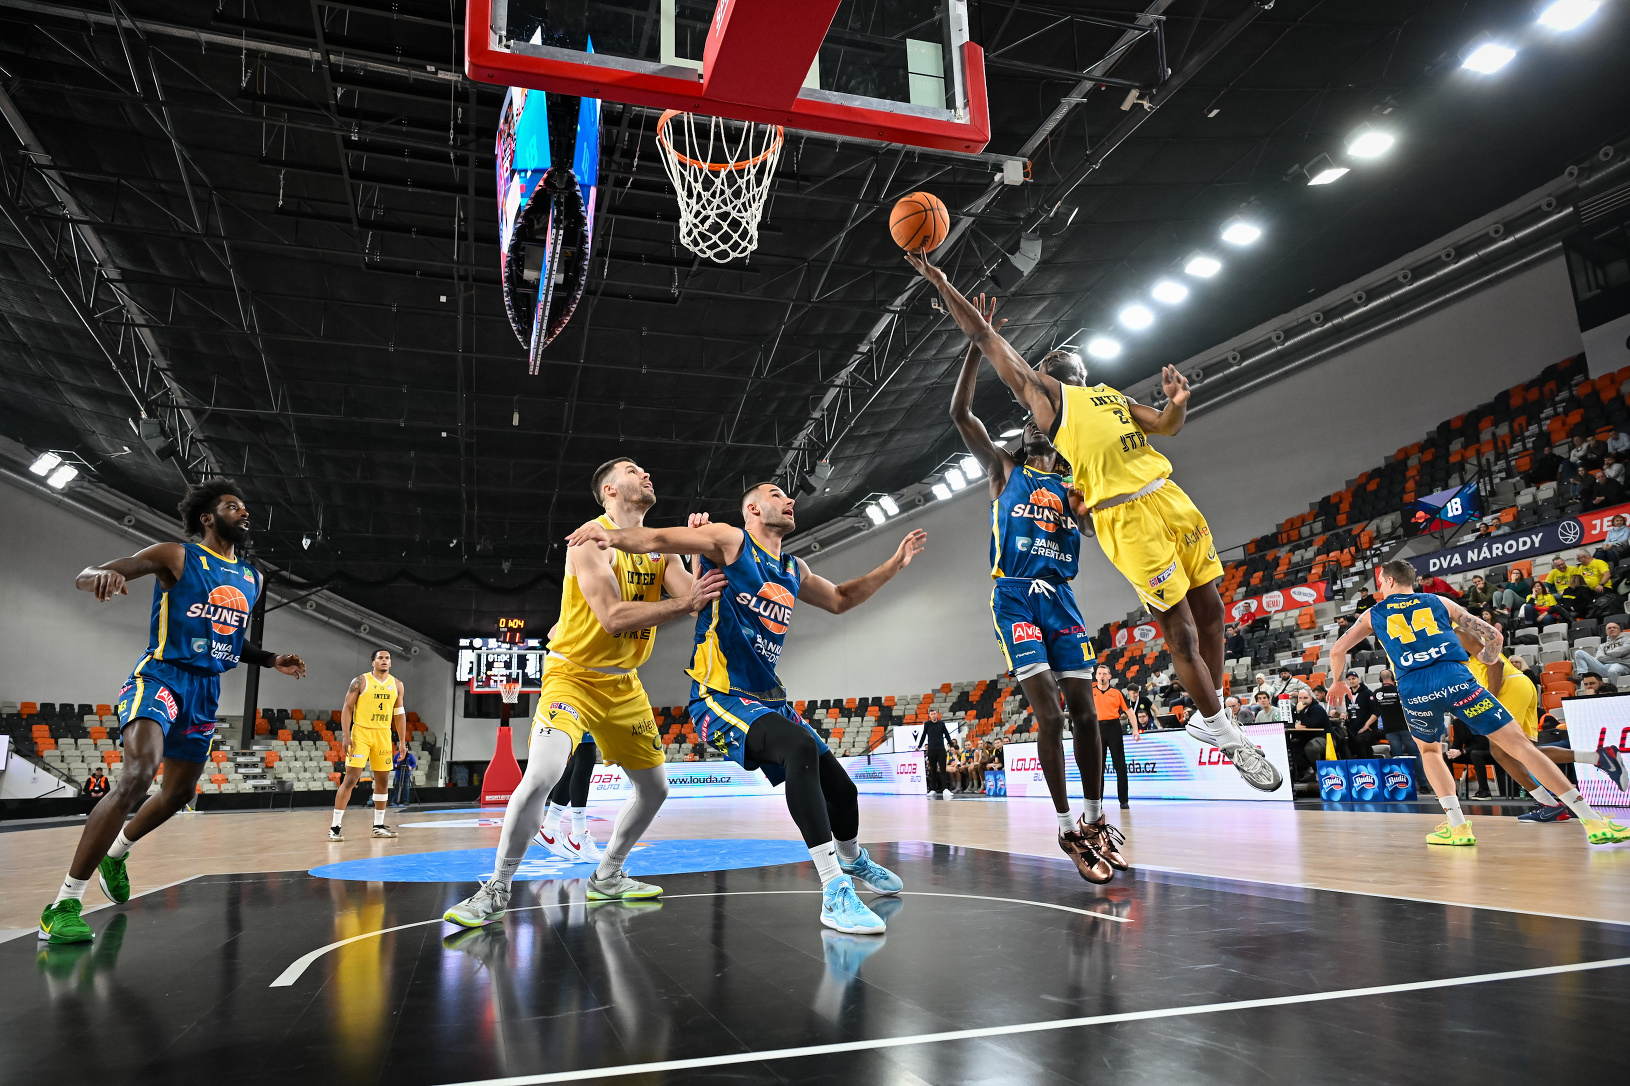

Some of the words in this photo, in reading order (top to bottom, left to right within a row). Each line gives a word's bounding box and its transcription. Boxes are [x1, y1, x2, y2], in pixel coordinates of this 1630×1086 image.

[1446, 497, 1463, 518] 18
[1428, 553, 1463, 573] DVA
[1466, 532, 1544, 564] NÁRODY
[627, 570, 657, 586] INTER
[1386, 607, 1444, 645] 44
[1400, 641, 1451, 667] Ústí
[378, 702, 383, 711] 4
